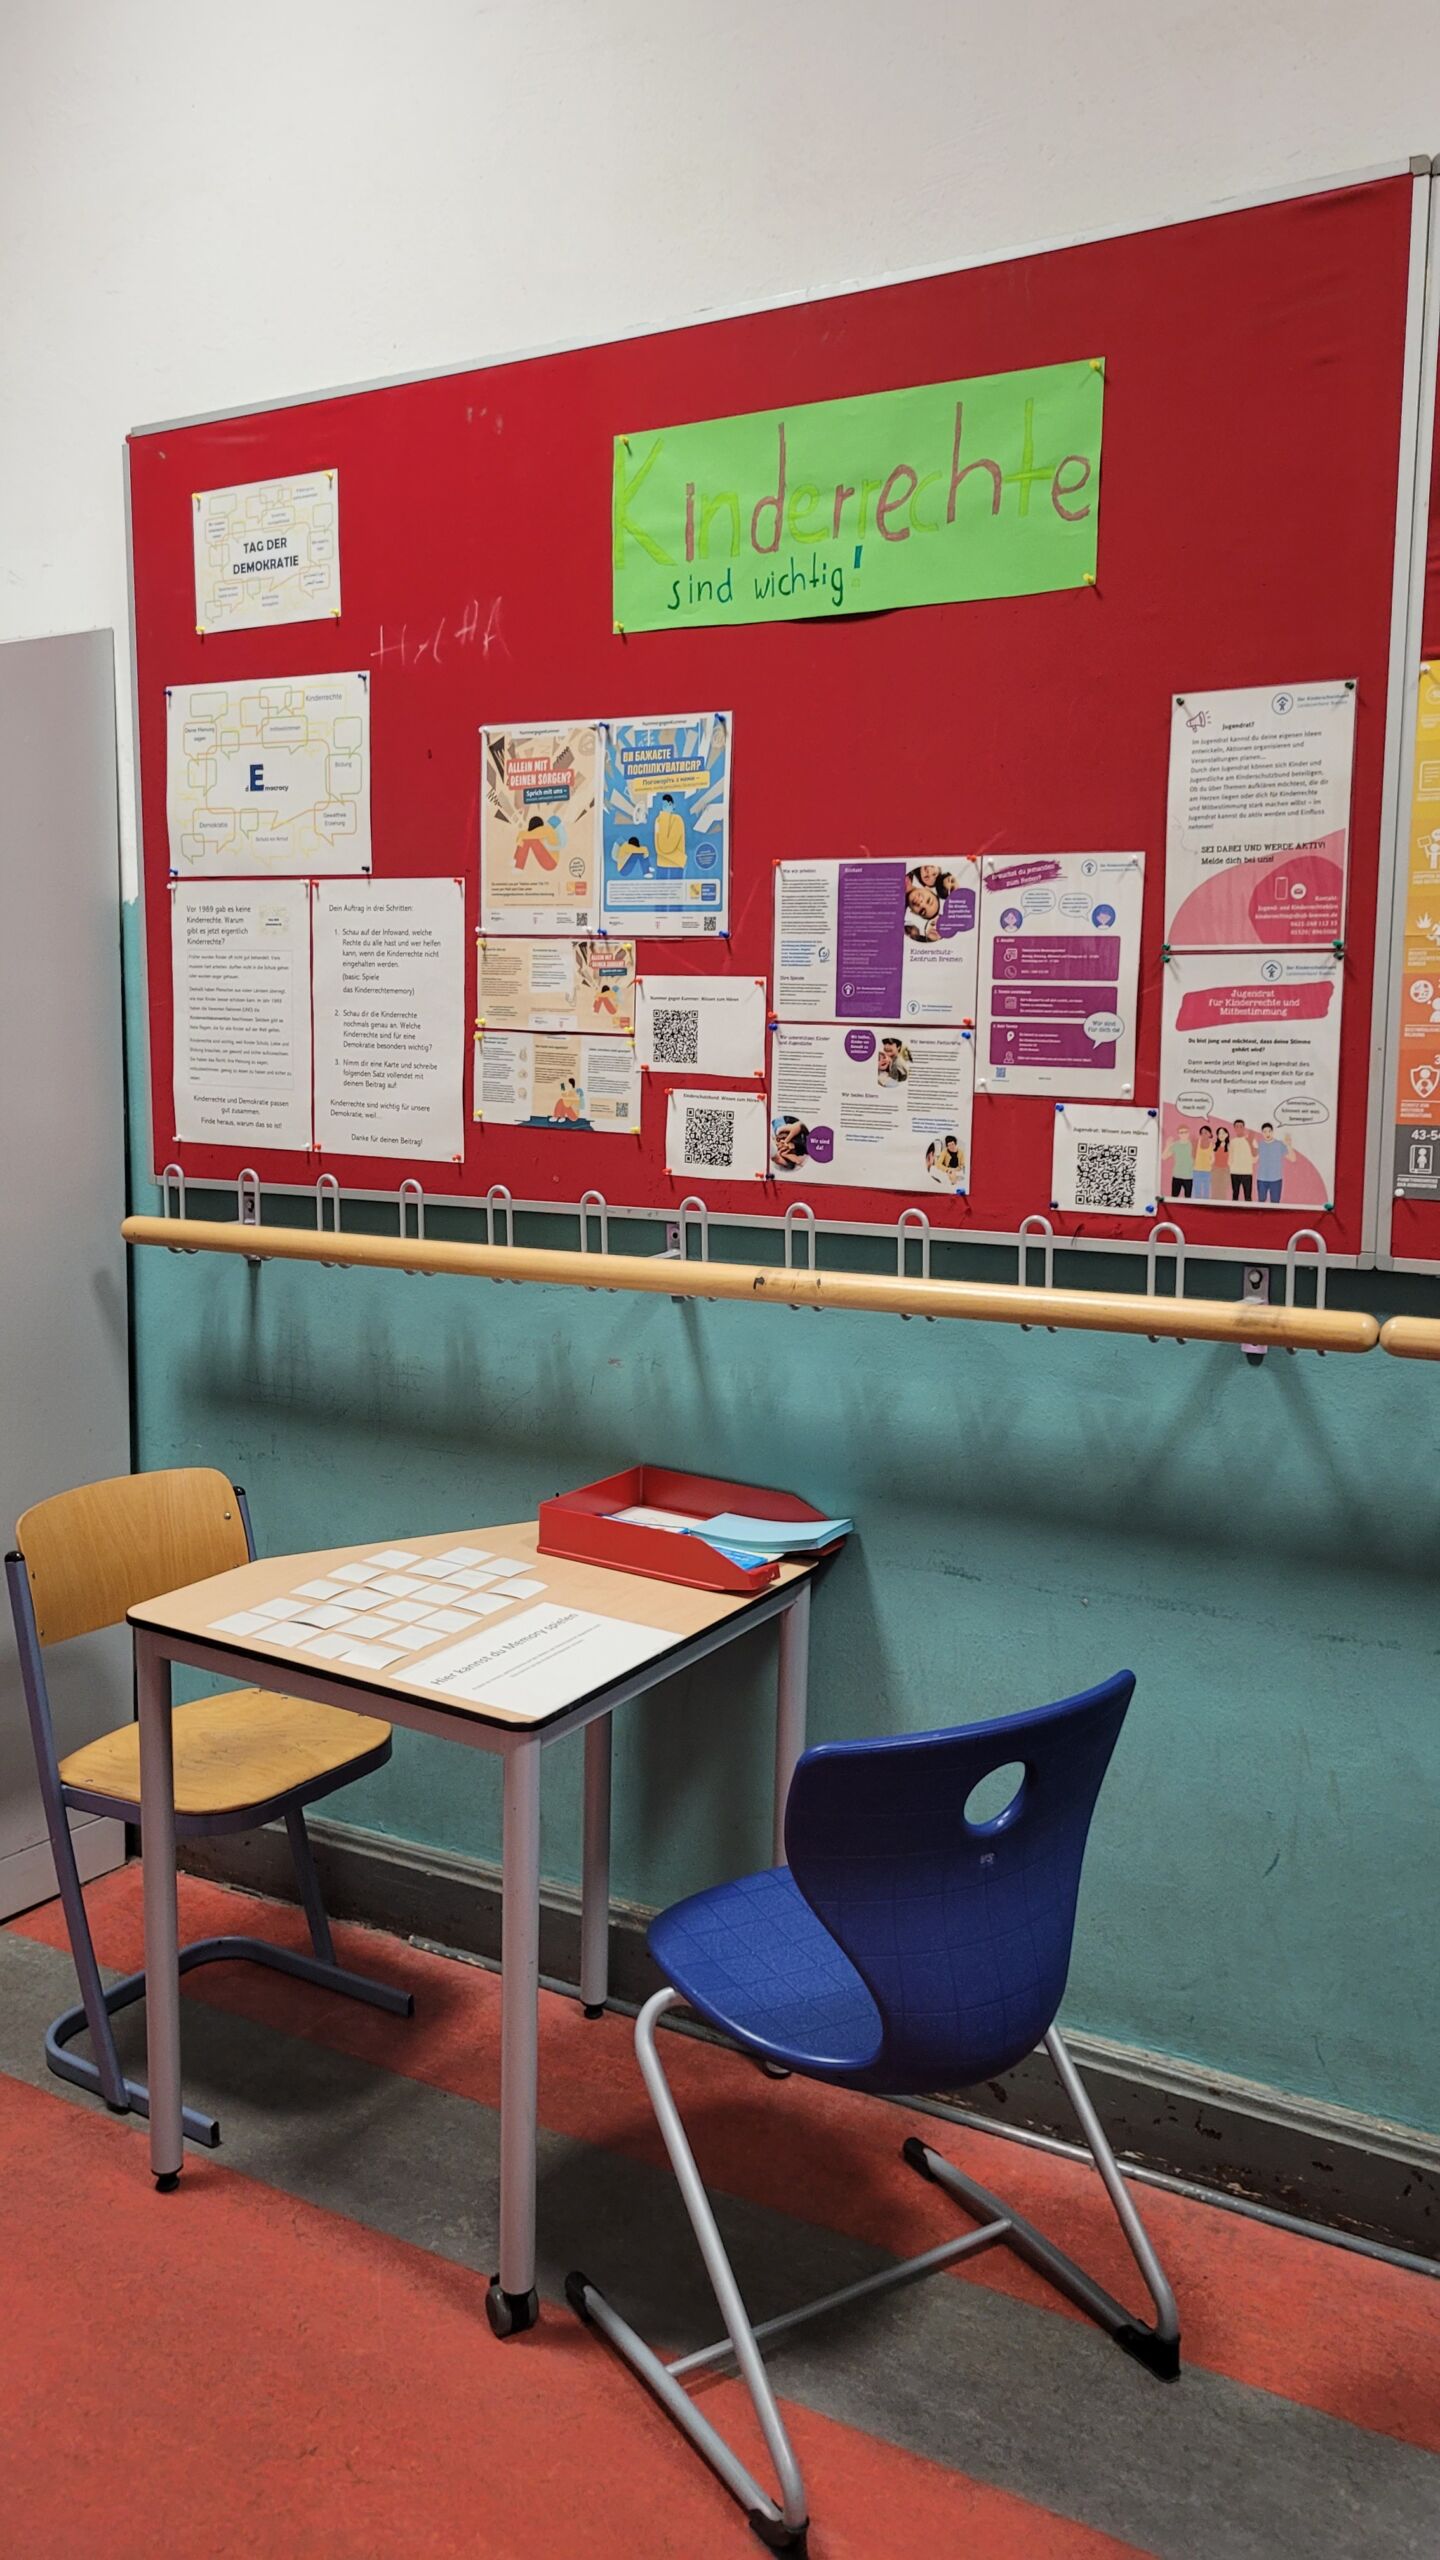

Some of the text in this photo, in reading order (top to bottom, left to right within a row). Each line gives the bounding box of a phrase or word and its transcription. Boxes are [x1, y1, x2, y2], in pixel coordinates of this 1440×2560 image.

[615, 397, 1092, 571] Kinderrechte
[243, 538, 288, 554] TAG DER
[232, 555, 299, 575] DEMOKRATIE
[668, 544, 864, 611] sind wichtig!
[305, 693, 343, 702] Kinderrechte
[508, 760, 548, 773] ALLEIN MIT
[510, 771, 572, 786] DEINEN SORGEN?
[526, 789, 542, 797] Sprich
[1231, 990, 1275, 998] Jugendrat
[1209, 998, 1300, 1006] für Kinderrechte und
[1220, 1008, 1288, 1017] Mitbestimmung
[407, 1043, 432, 1052] wichtig?
[194, 1095, 225, 1103] Kinderrechte
[238, 1097, 268, 1105] Demokratie
[1411, 1129, 1440, 1141] 43-5
[379, 1136, 398, 1144] deinen
[399, 1137, 422, 1147] Beitrag!
[431, 1612, 579, 1686] Hier kannst du Memory spielen
